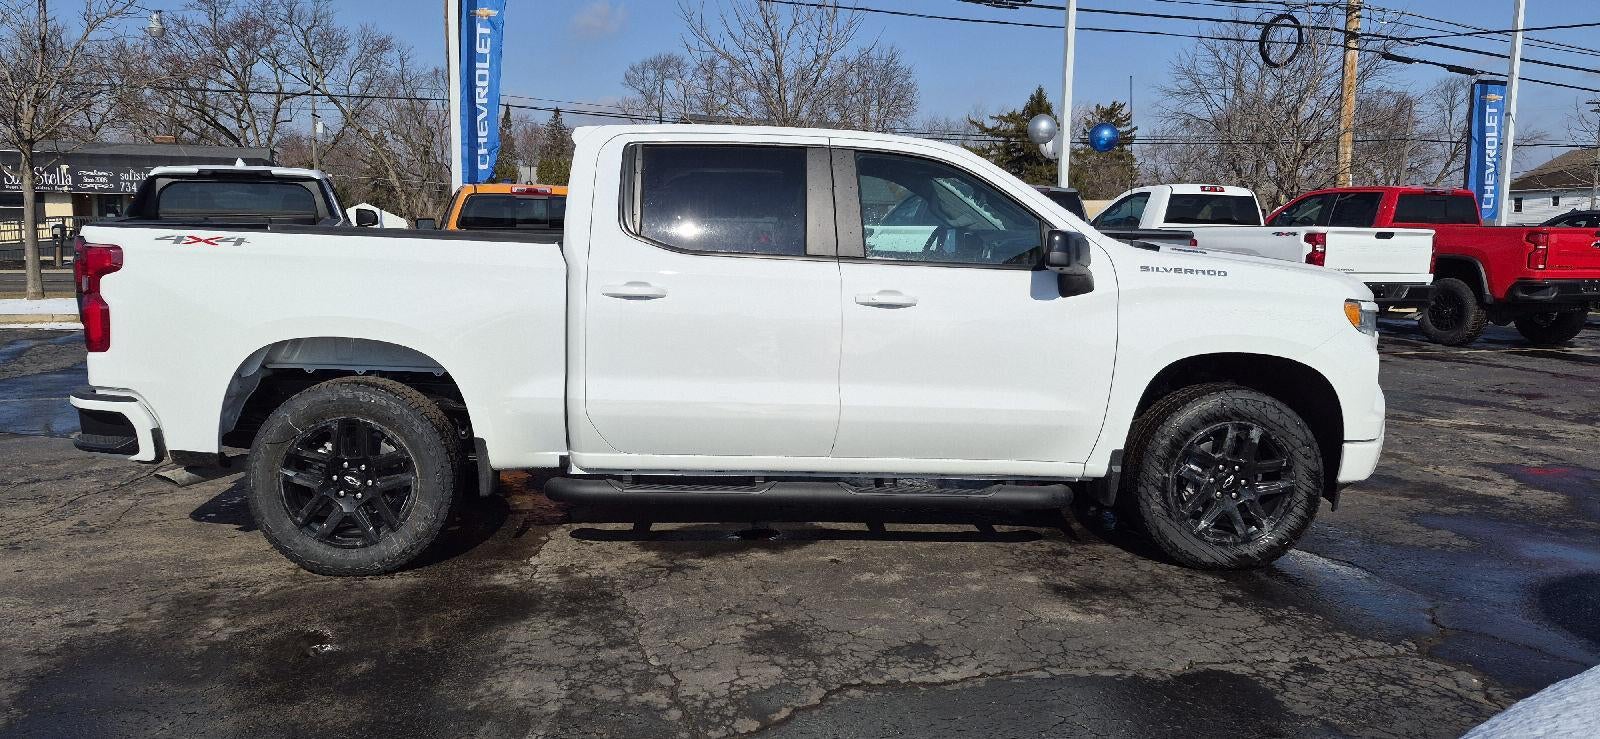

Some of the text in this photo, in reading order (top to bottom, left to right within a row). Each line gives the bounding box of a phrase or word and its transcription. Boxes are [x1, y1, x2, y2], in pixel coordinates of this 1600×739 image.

[476, 23, 491, 170] CHEVROLET
[1482, 105, 1498, 209] CHEVROLET
[120, 181, 138, 193] 734
[1139, 265, 1228, 277] SILVERADO
